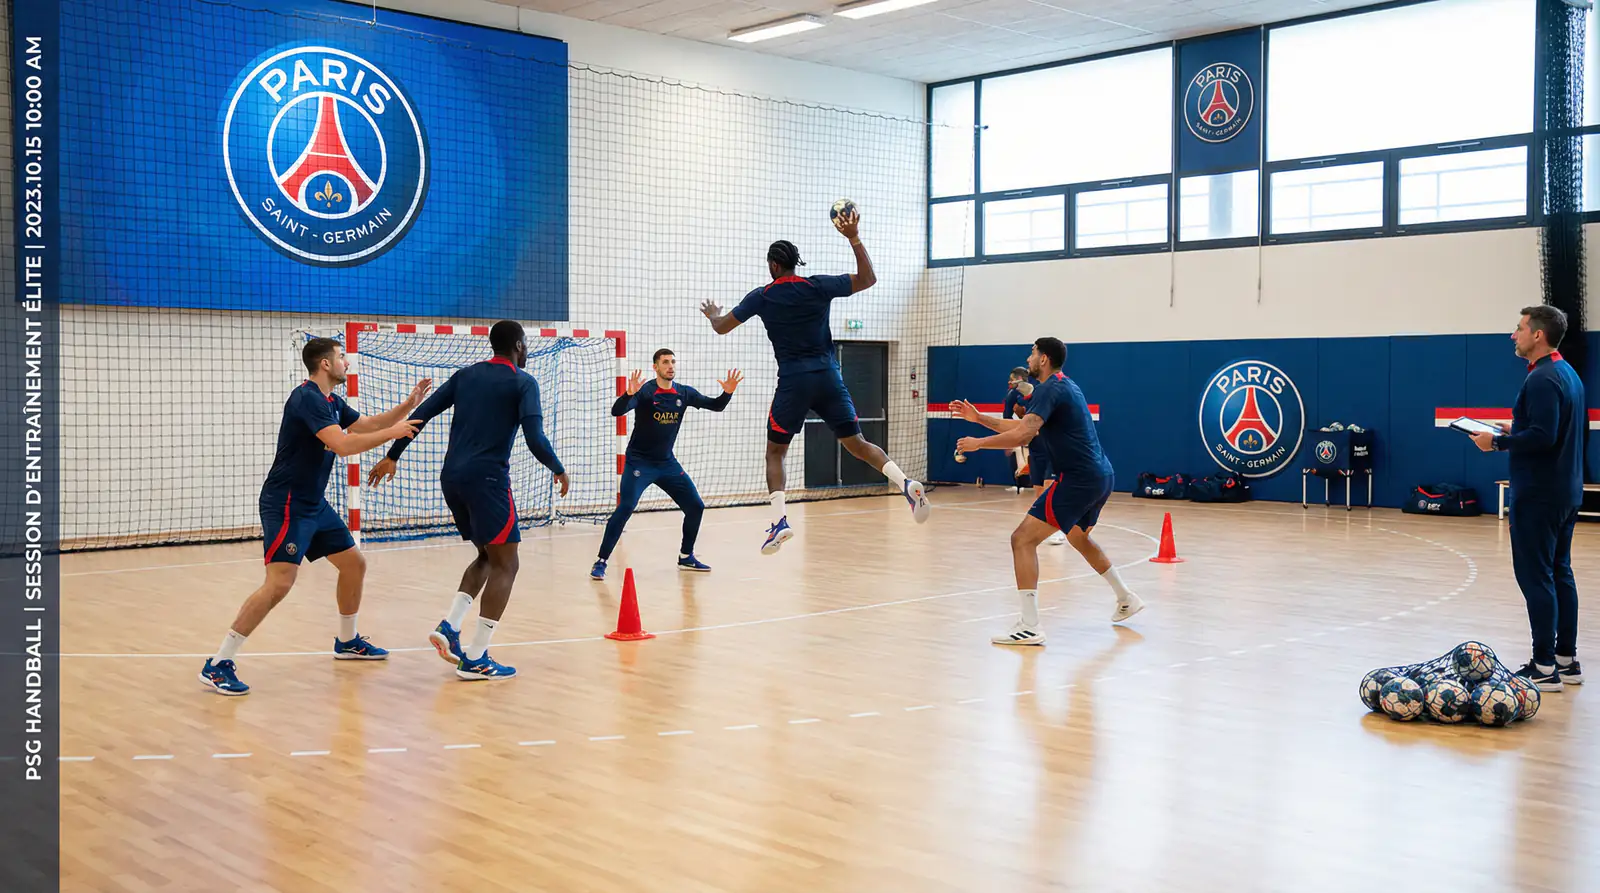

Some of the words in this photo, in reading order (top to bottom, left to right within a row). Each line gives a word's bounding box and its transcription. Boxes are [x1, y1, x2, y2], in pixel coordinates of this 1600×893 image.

[259, 58, 392, 115] PARIS
[1195, 66, 1241, 87] PARIS
[261, 197, 309, 237] SAINT
[323, 207, 393, 244] GERMAIN
[1216, 366, 1286, 394] PARIS
[653, 411, 679, 421] QATAR
[1216, 443, 1240, 465] SAINT
[1247, 446, 1286, 468] GERMAIN
